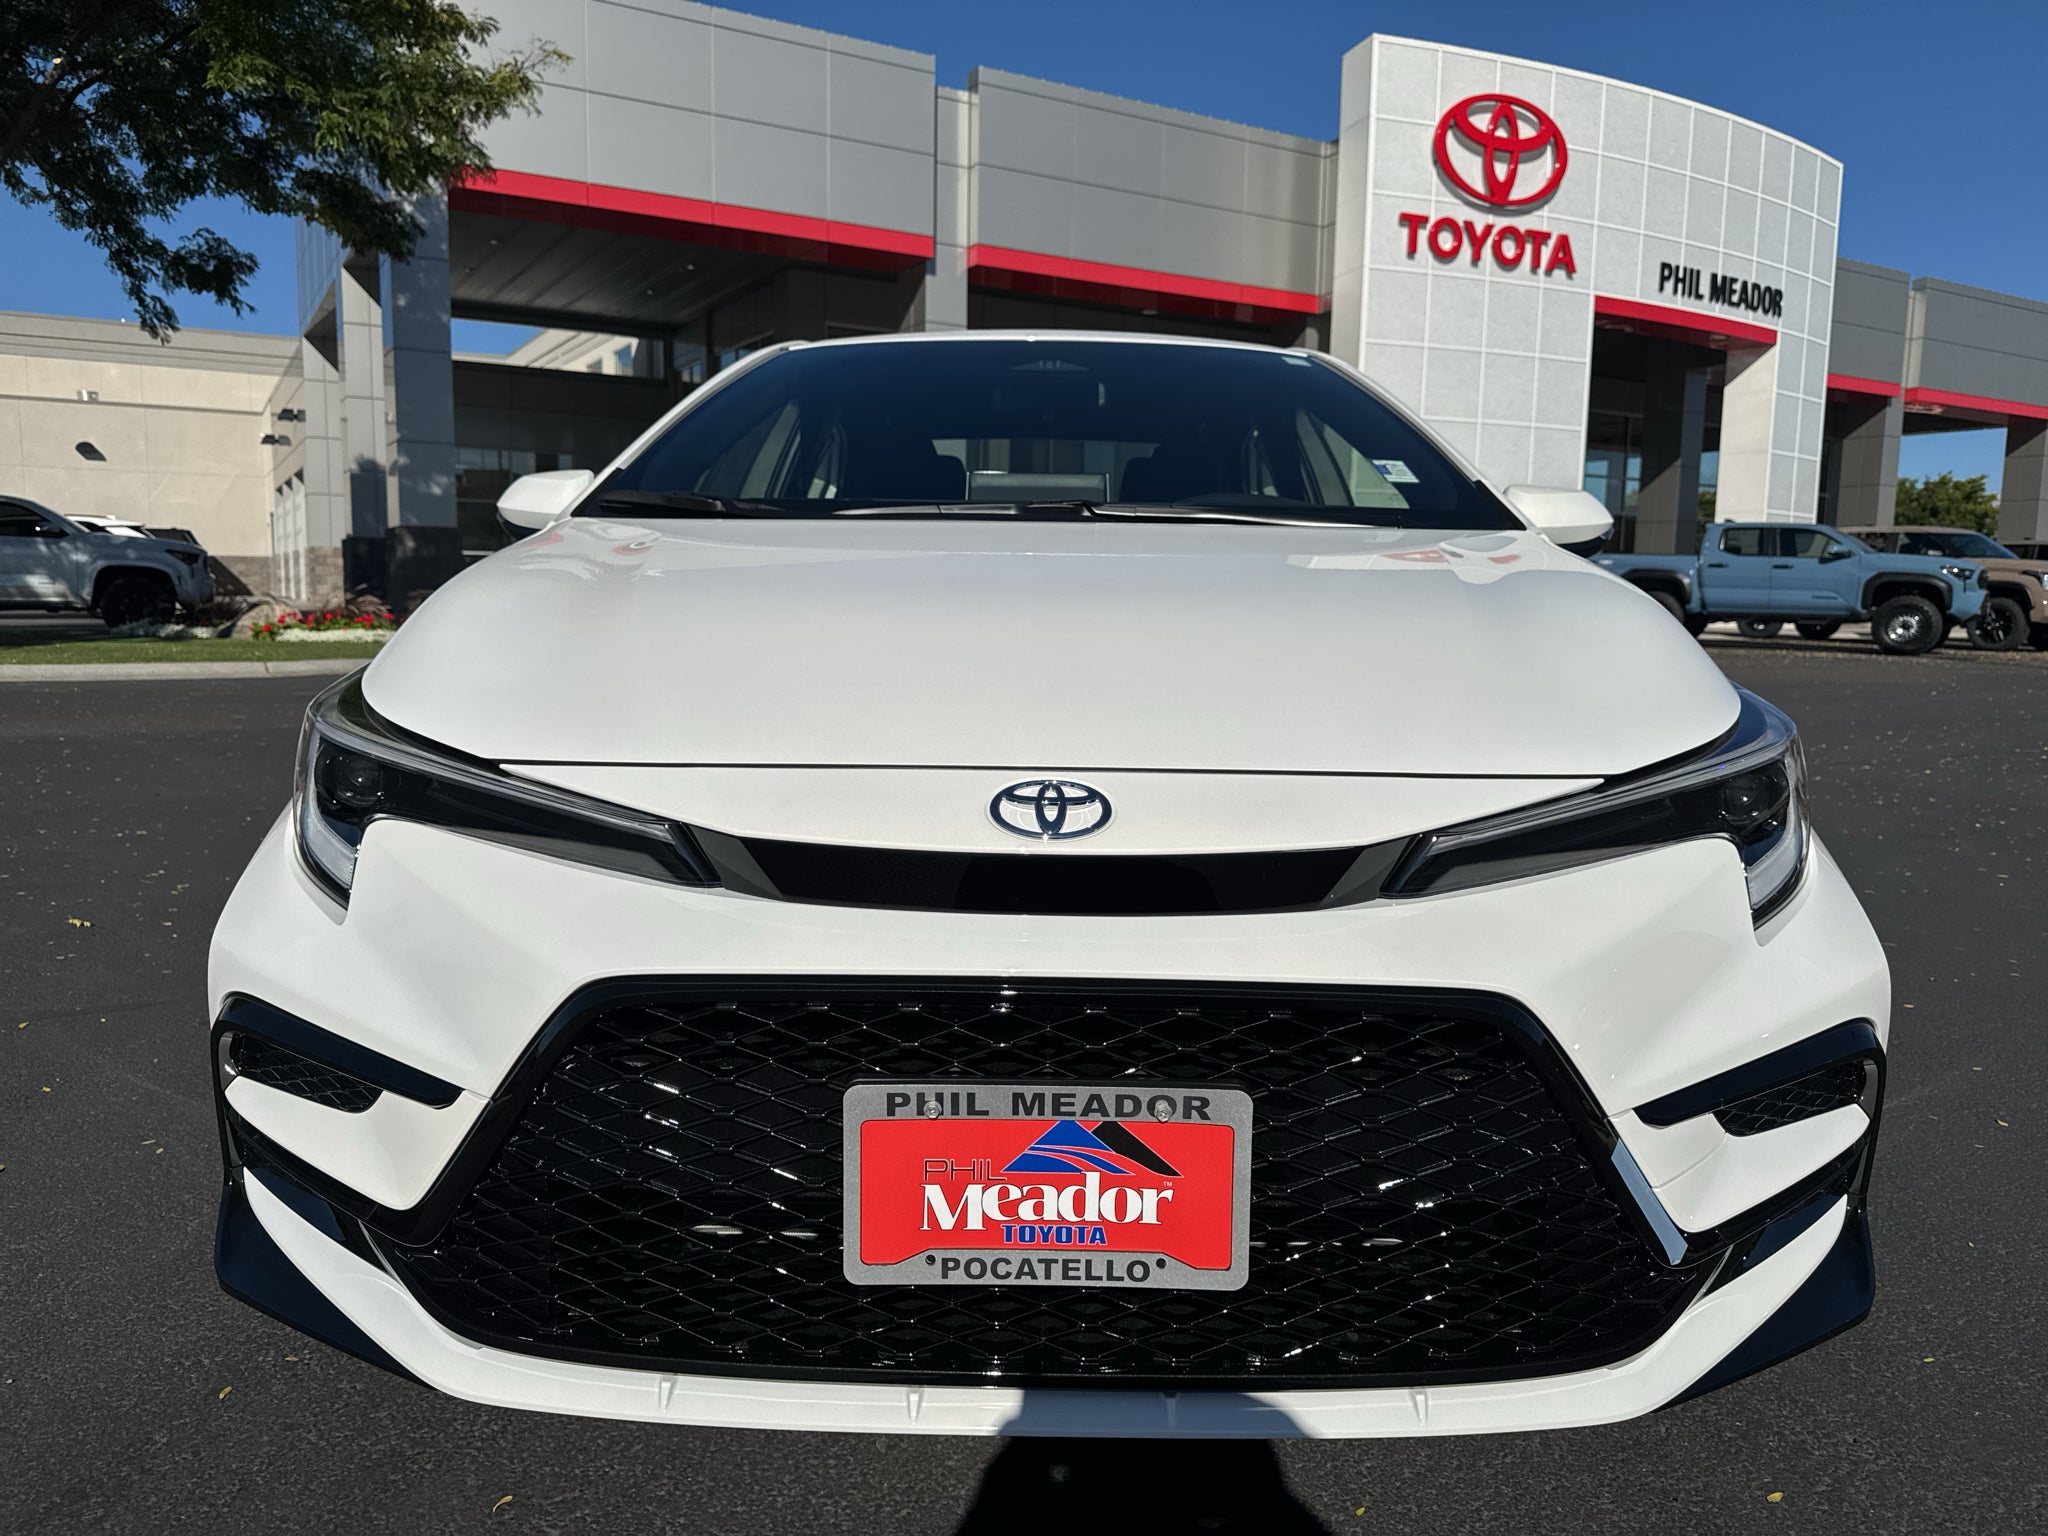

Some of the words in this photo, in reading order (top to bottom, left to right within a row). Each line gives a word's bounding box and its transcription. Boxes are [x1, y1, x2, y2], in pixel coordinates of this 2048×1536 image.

[1399, 212, 1576, 277] TOYOTA
[1659, 262, 1704, 300] PHIL
[1709, 272, 1783, 318] MEADOR
[886, 1092, 989, 1117] PHIL
[1011, 1092, 1211, 1120] MEADOR
[923, 1158, 1007, 1181] PHIL
[919, 1171, 1174, 1231] Meador
[1001, 1224, 1107, 1245] TOYOTA
[940, 1257, 1150, 1282] POCATELLO
